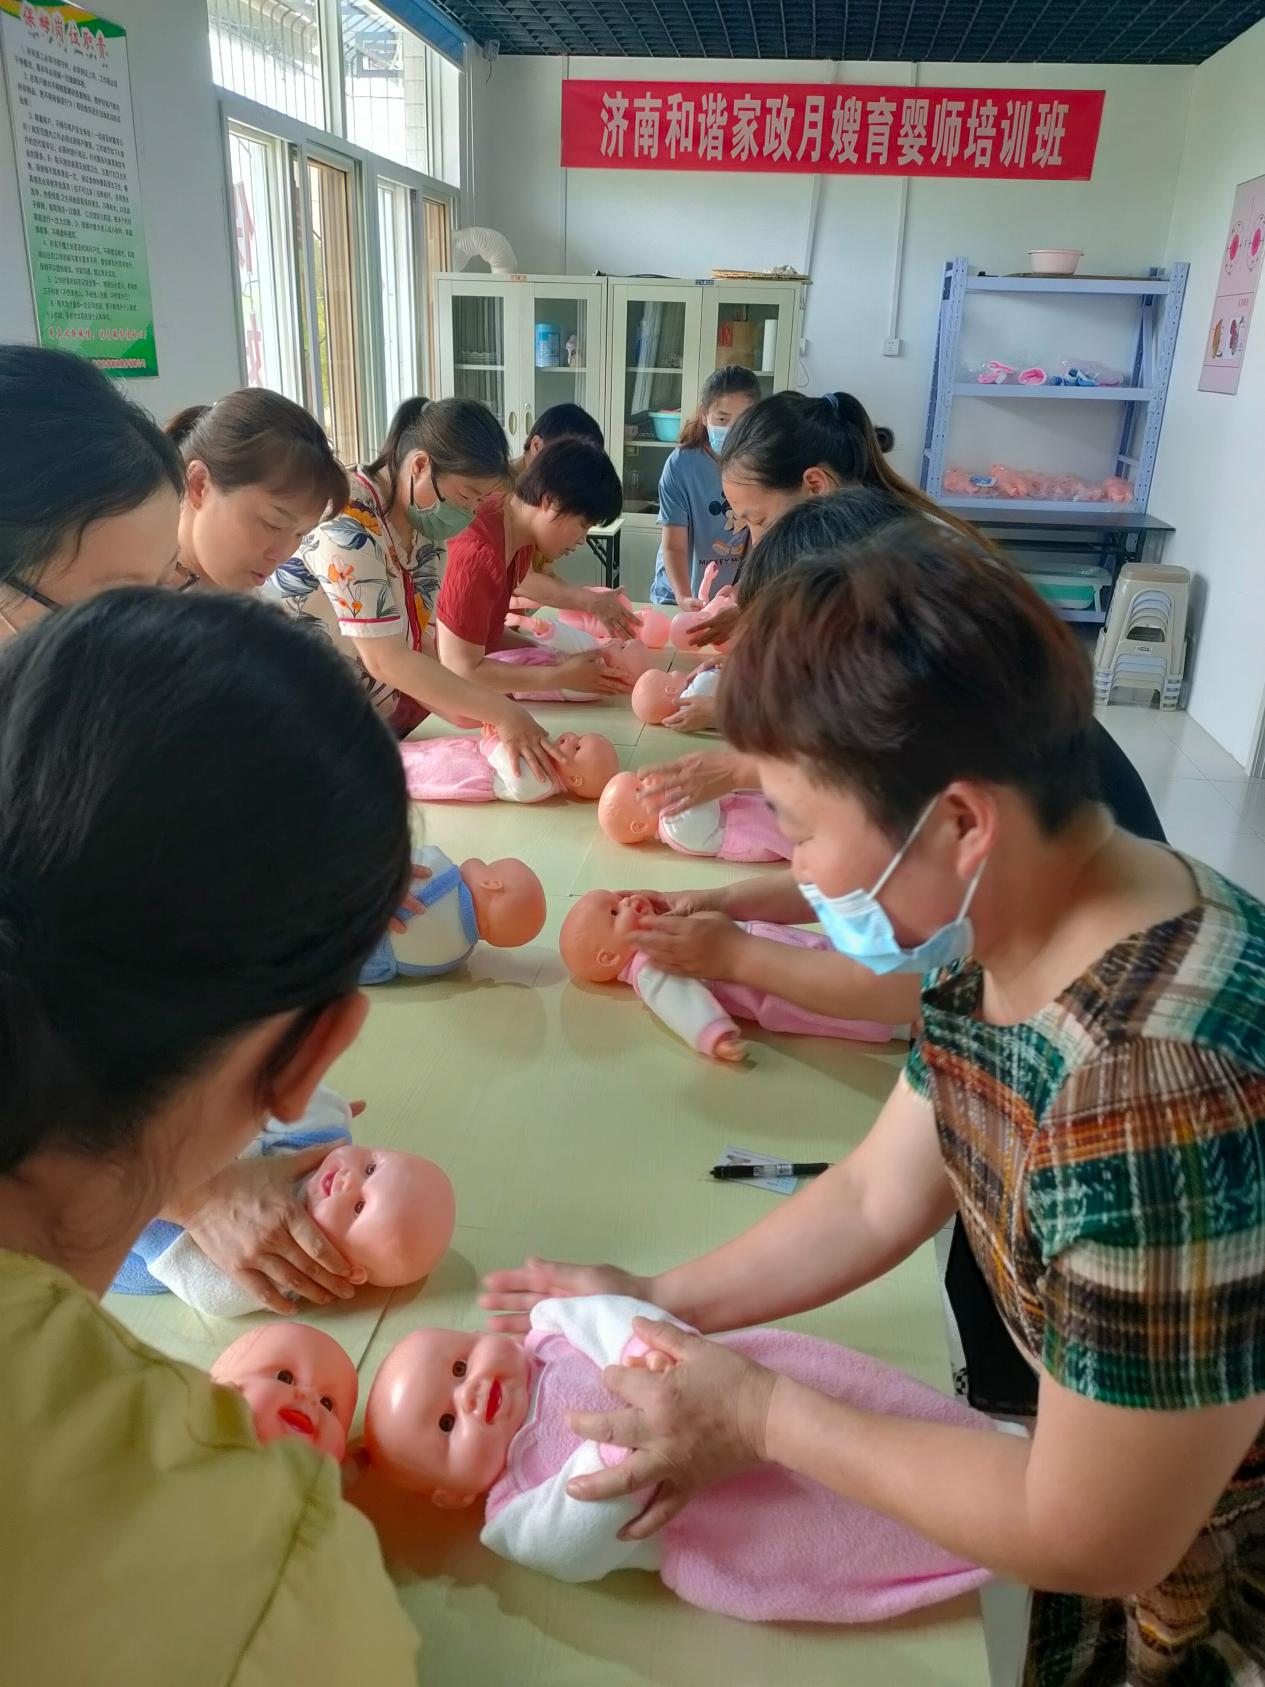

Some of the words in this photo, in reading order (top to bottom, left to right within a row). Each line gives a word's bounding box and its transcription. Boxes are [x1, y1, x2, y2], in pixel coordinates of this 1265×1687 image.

[600, 91, 1070, 168] 济南和谐家政月嫂育婴师培训班
